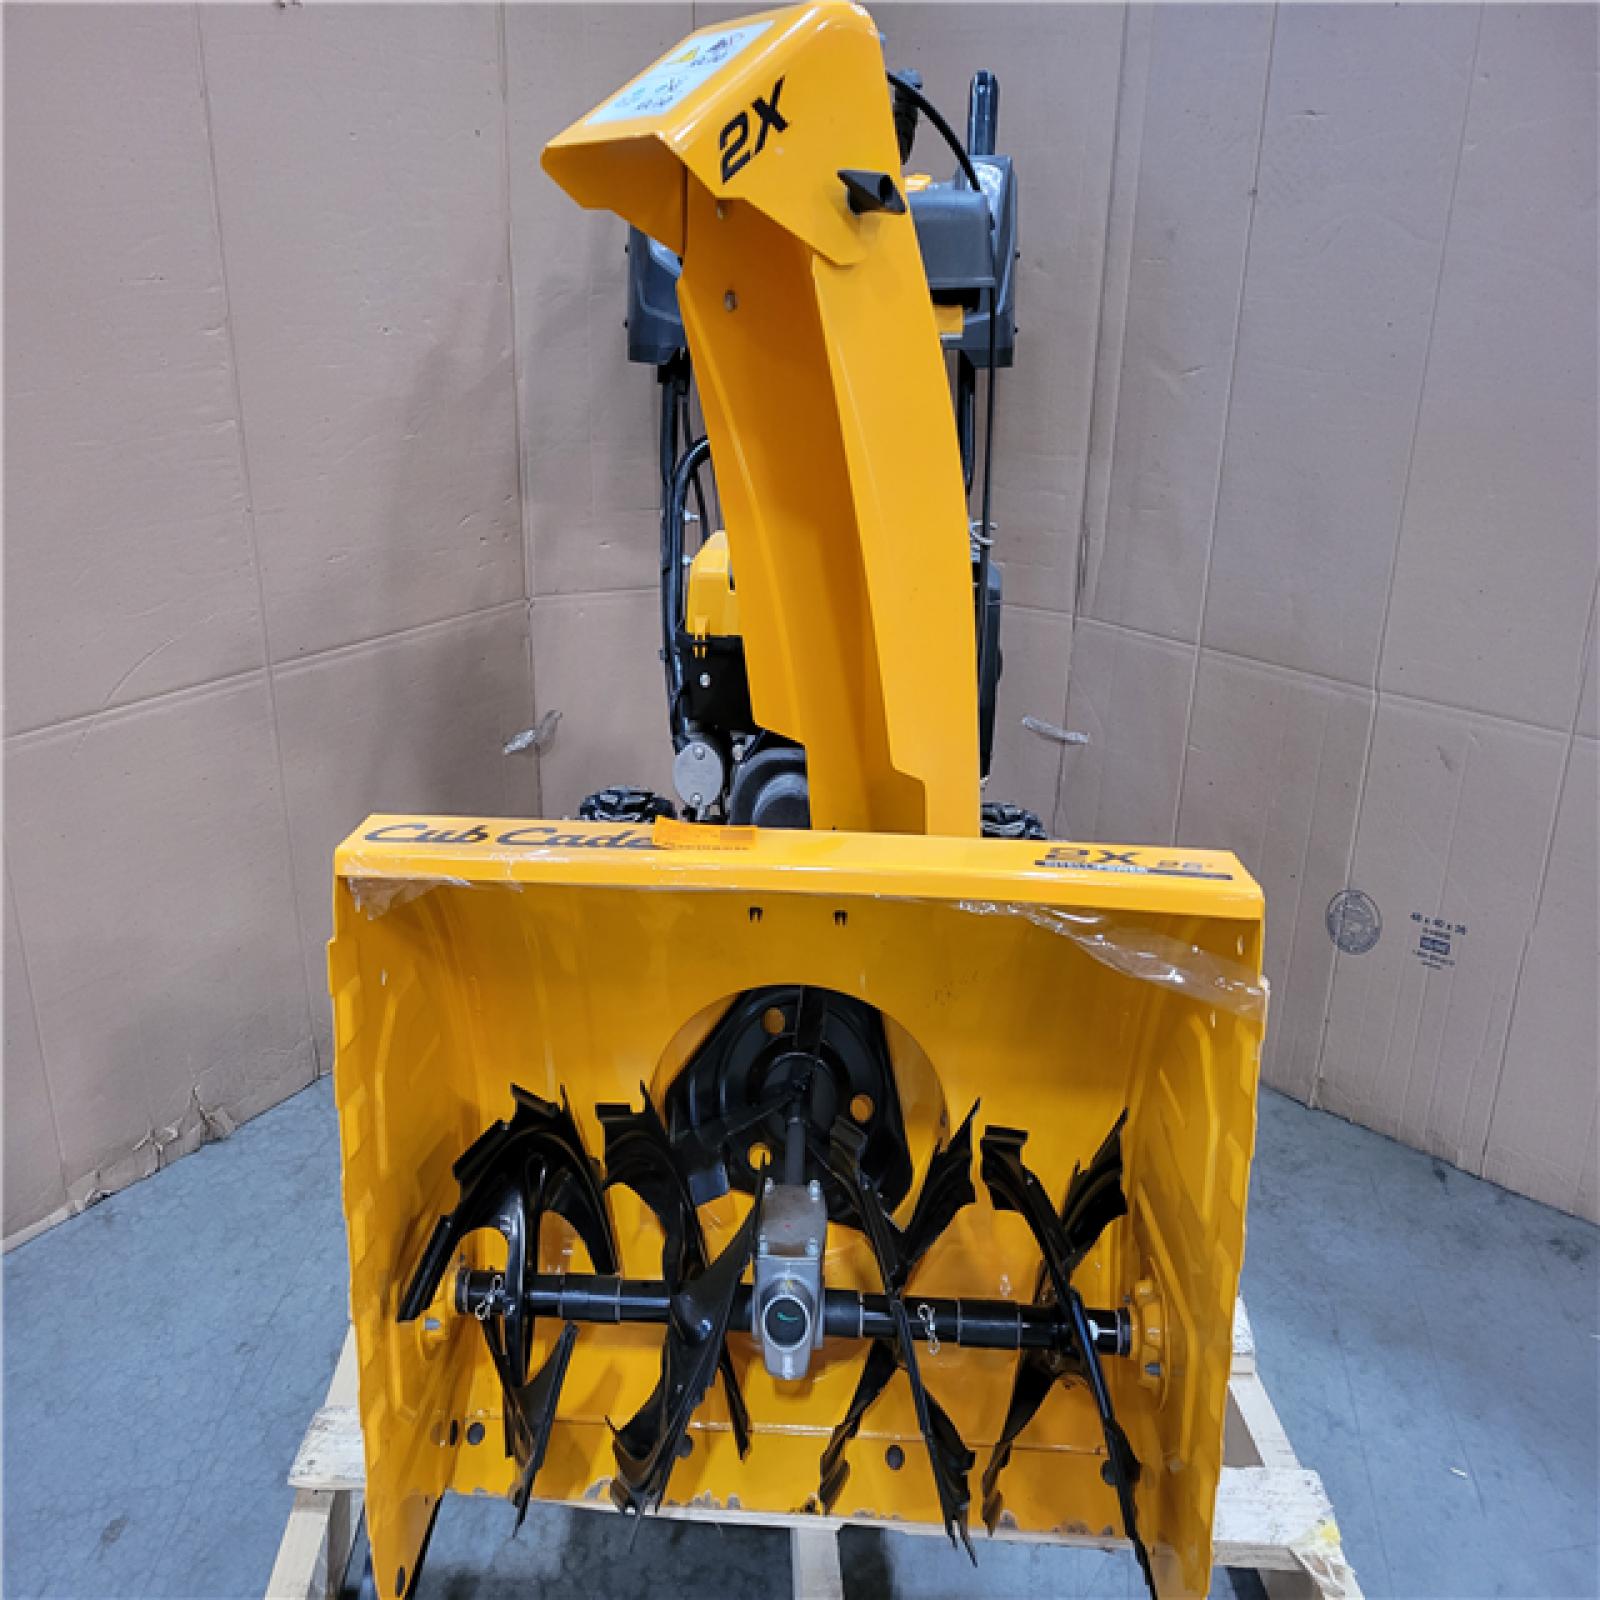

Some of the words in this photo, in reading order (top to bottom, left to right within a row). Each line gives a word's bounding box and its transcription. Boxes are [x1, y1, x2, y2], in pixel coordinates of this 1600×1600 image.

[719, 75, 788, 185] 2X
[364, 824, 489, 843] Cub
[496, 827, 663, 850] Cade
